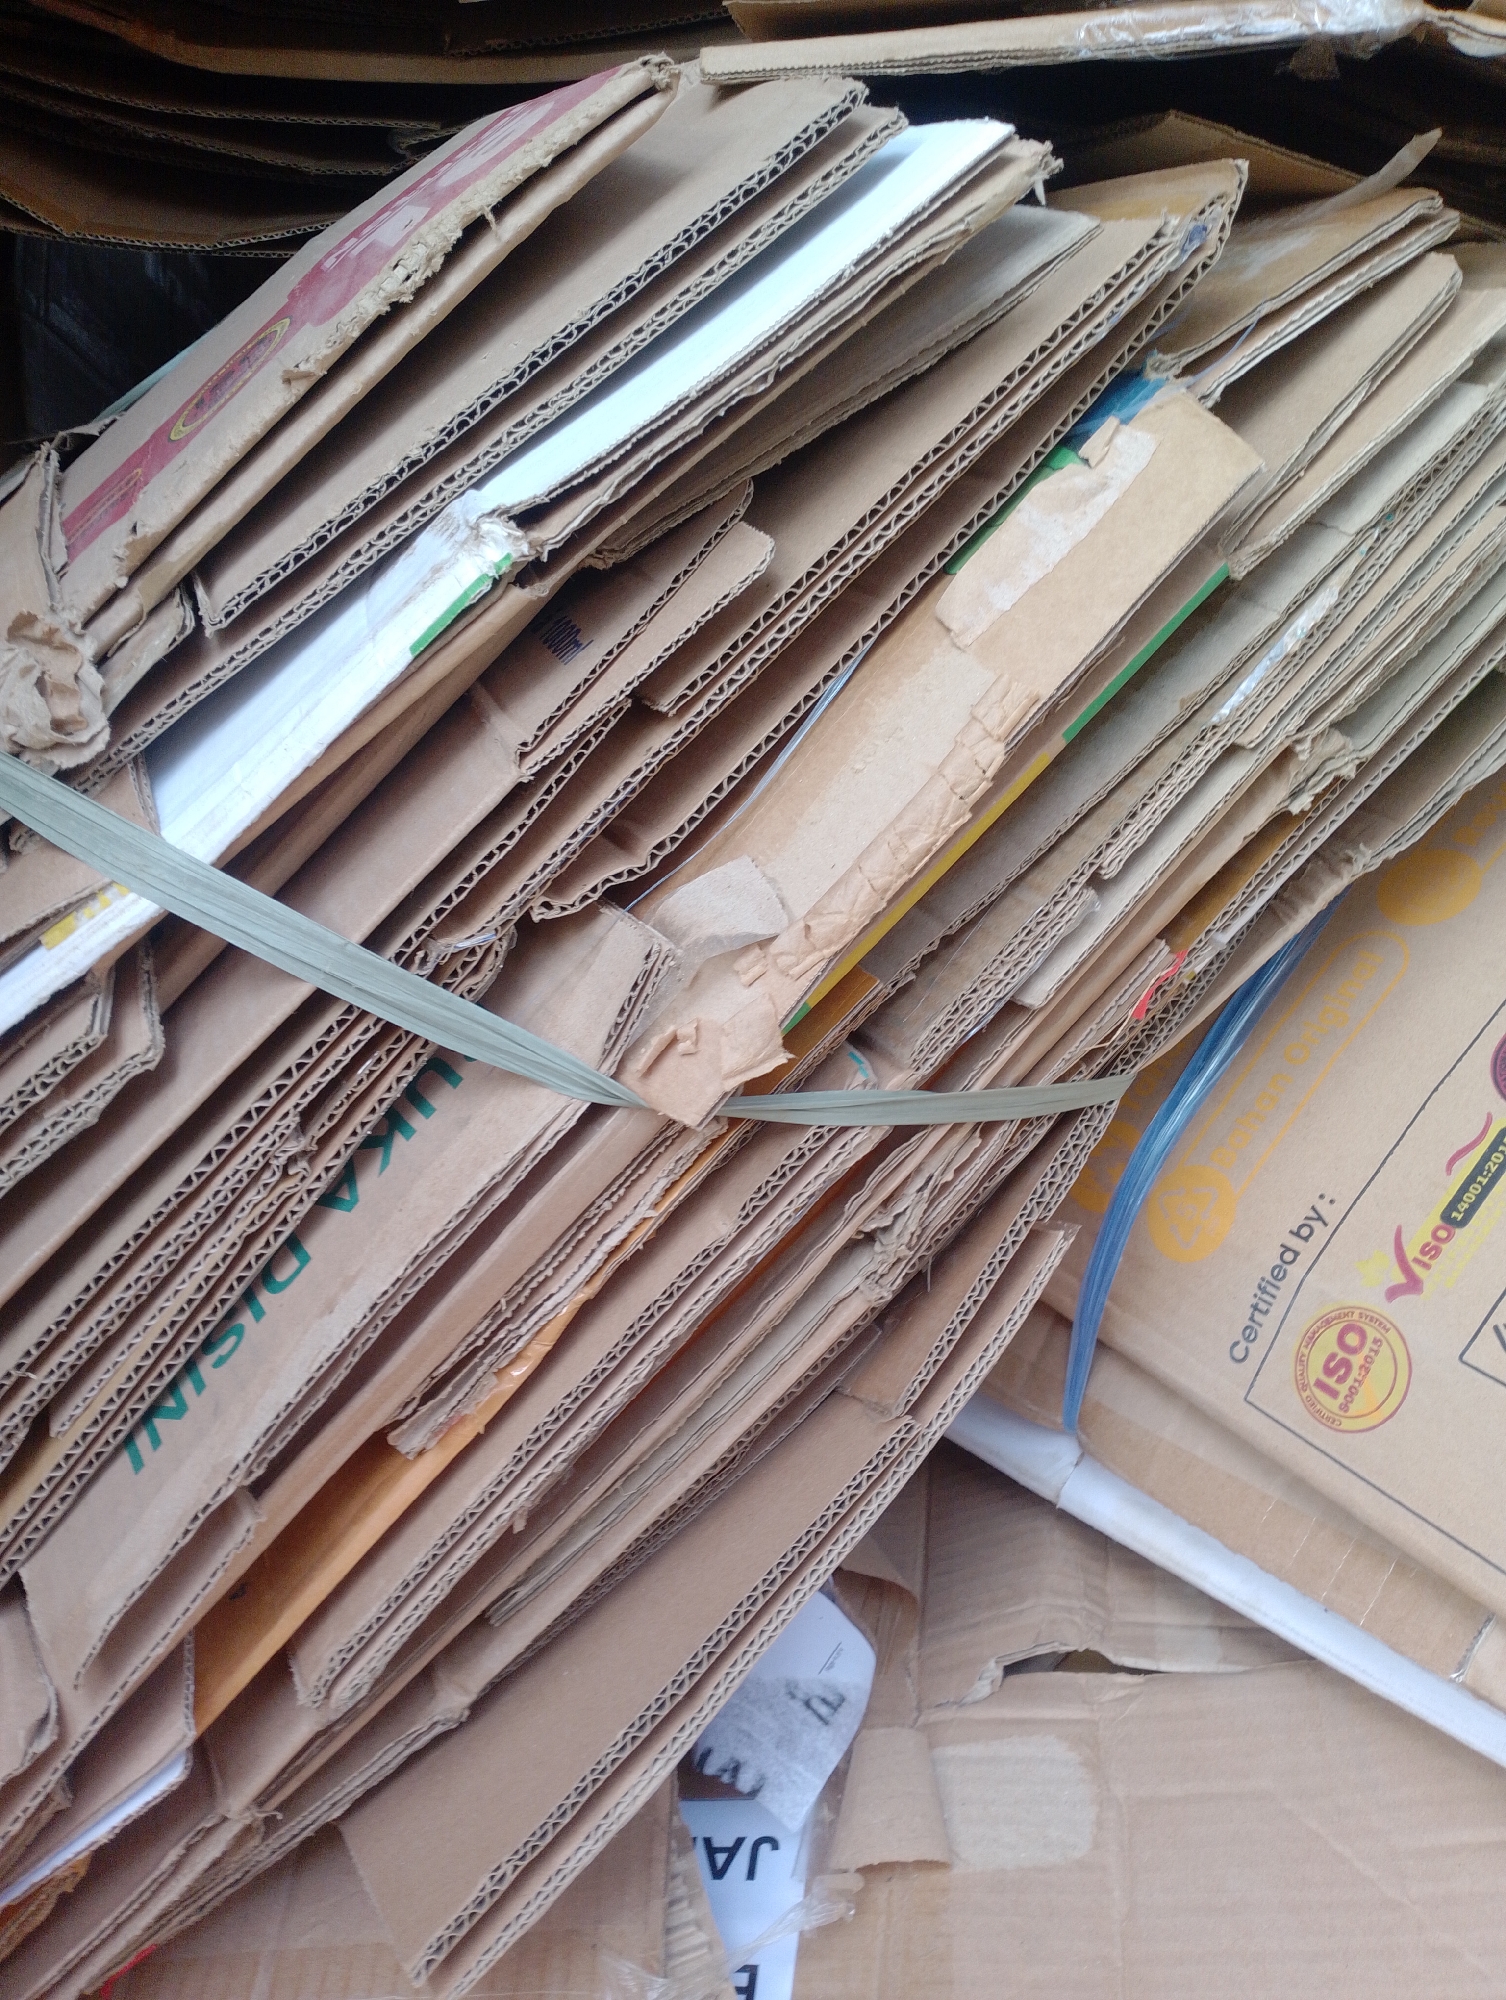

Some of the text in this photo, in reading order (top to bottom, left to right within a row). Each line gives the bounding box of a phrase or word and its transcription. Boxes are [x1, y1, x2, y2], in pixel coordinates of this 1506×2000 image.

[1209, 949, 1386, 1170] Bahan Original
[123, 1032, 480, 1475] UKA DISINI
[1411, 1223, 1456, 1271] ISO
[1229, 1243, 1301, 1364] Certified
[1313, 1323, 1368, 1400] ISO
[1305, 1395, 1342, 1427] CERTIFIED
[690, 1836, 780, 1881] JA
